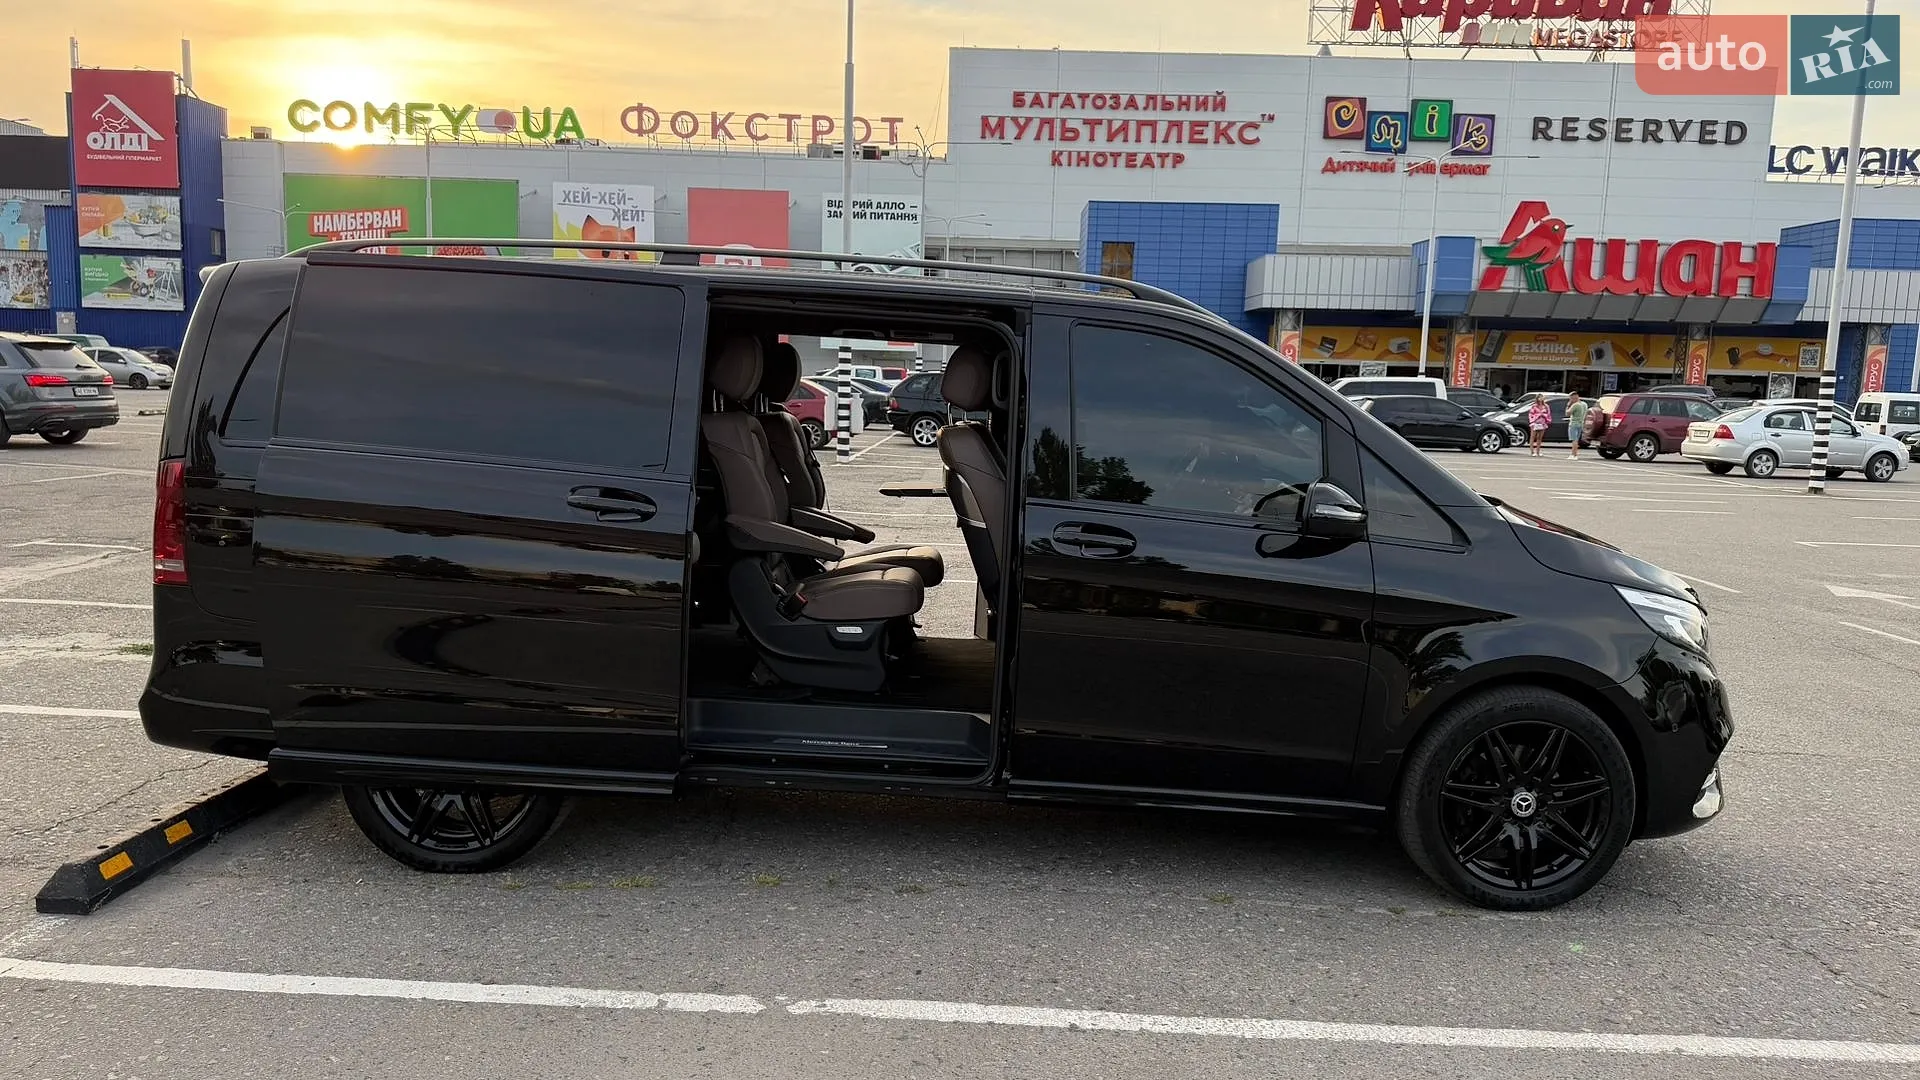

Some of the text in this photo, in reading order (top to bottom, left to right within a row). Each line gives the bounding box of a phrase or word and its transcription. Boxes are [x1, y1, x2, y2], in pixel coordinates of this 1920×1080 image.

[1535, 28, 1683, 49] MEGASTORE
[1012, 90, 1227, 113] БАГАТОЗАЛЬНИЙ
[288, 99, 585, 140] COMFY UA
[620, 103, 904, 146] ФОКСТРОТ
[980, 115, 1261, 145] МУЛЬТИПЛЕКС
[1532, 116, 1748, 145] RESERVED
[1051, 150, 1186, 169] КІНОТЕАТР
[1321, 157, 1396, 174] Дитячий
[1767, 145, 1815, 175] LC
[562, 187, 634, 206] ХЕЙ-ХЕЙ-
[827, 199, 873, 210] ВІДРИЙ
[875, 201, 906, 210] АЛЛО
[313, 209, 402, 233] НАМБЕРВАН
[611, 206, 645, 222] ХЕЙ!
[869, 211, 918, 221] ПИТАННЯ
[1478, 200, 1777, 298] Ашан
[1456, 351, 1468, 387] ИТРУС
[1691, 358, 1702, 385] ТРУС
